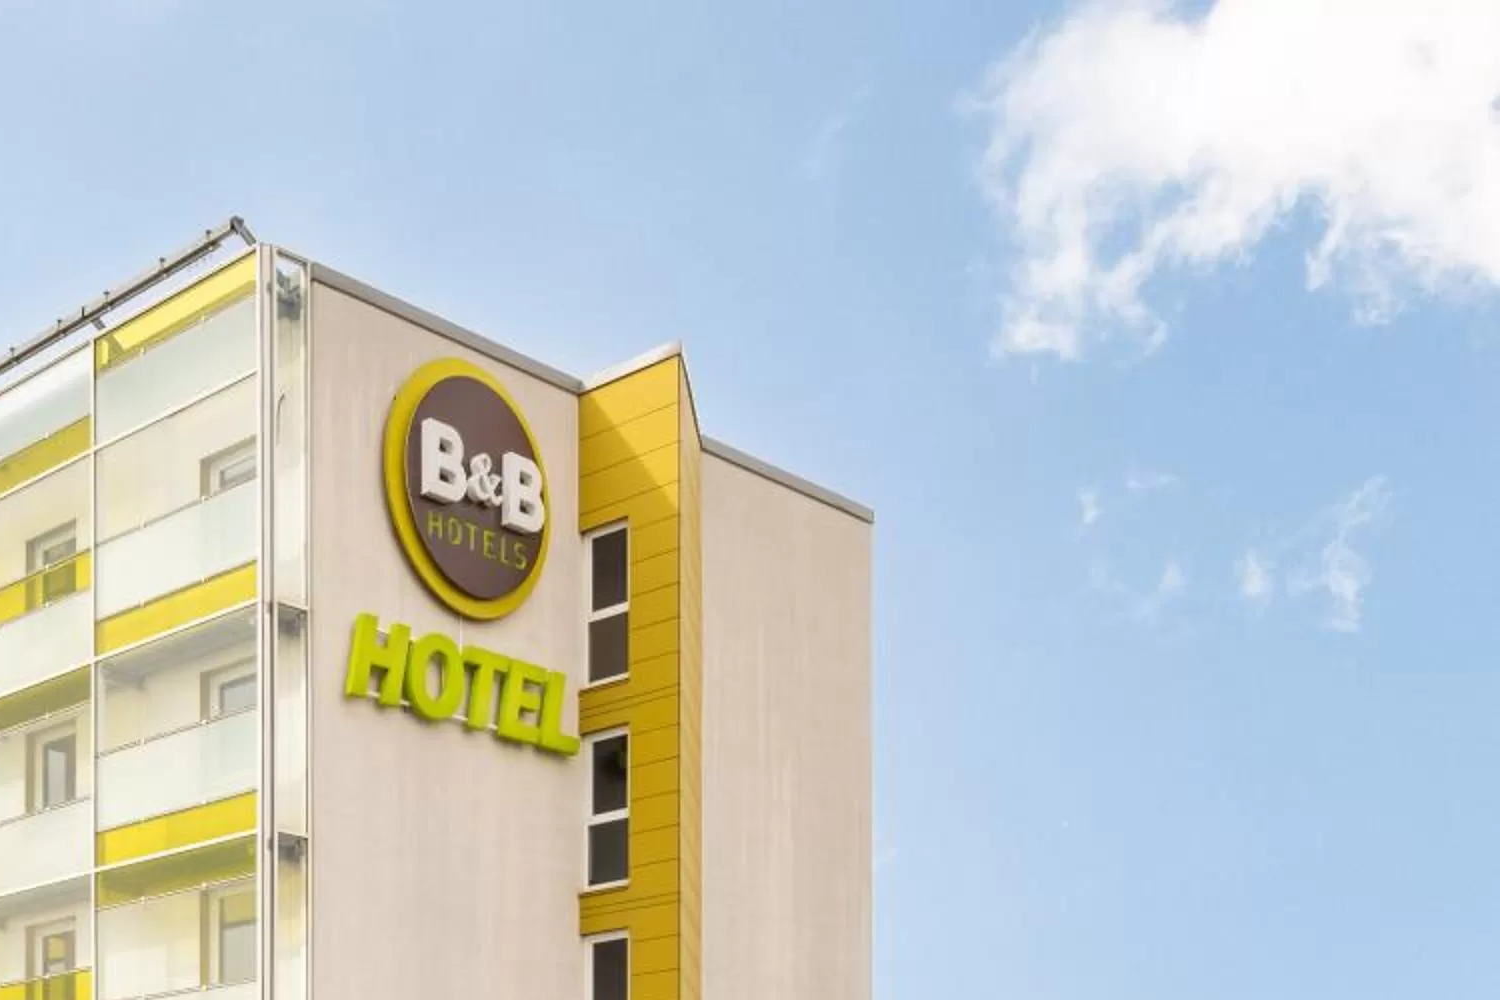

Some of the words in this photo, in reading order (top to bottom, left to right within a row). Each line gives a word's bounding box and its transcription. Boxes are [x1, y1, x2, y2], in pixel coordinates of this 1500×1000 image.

[420, 417, 545, 534] B&B
[427, 510, 528, 571] HOTELS
[346, 611, 581, 757] HOTEL
